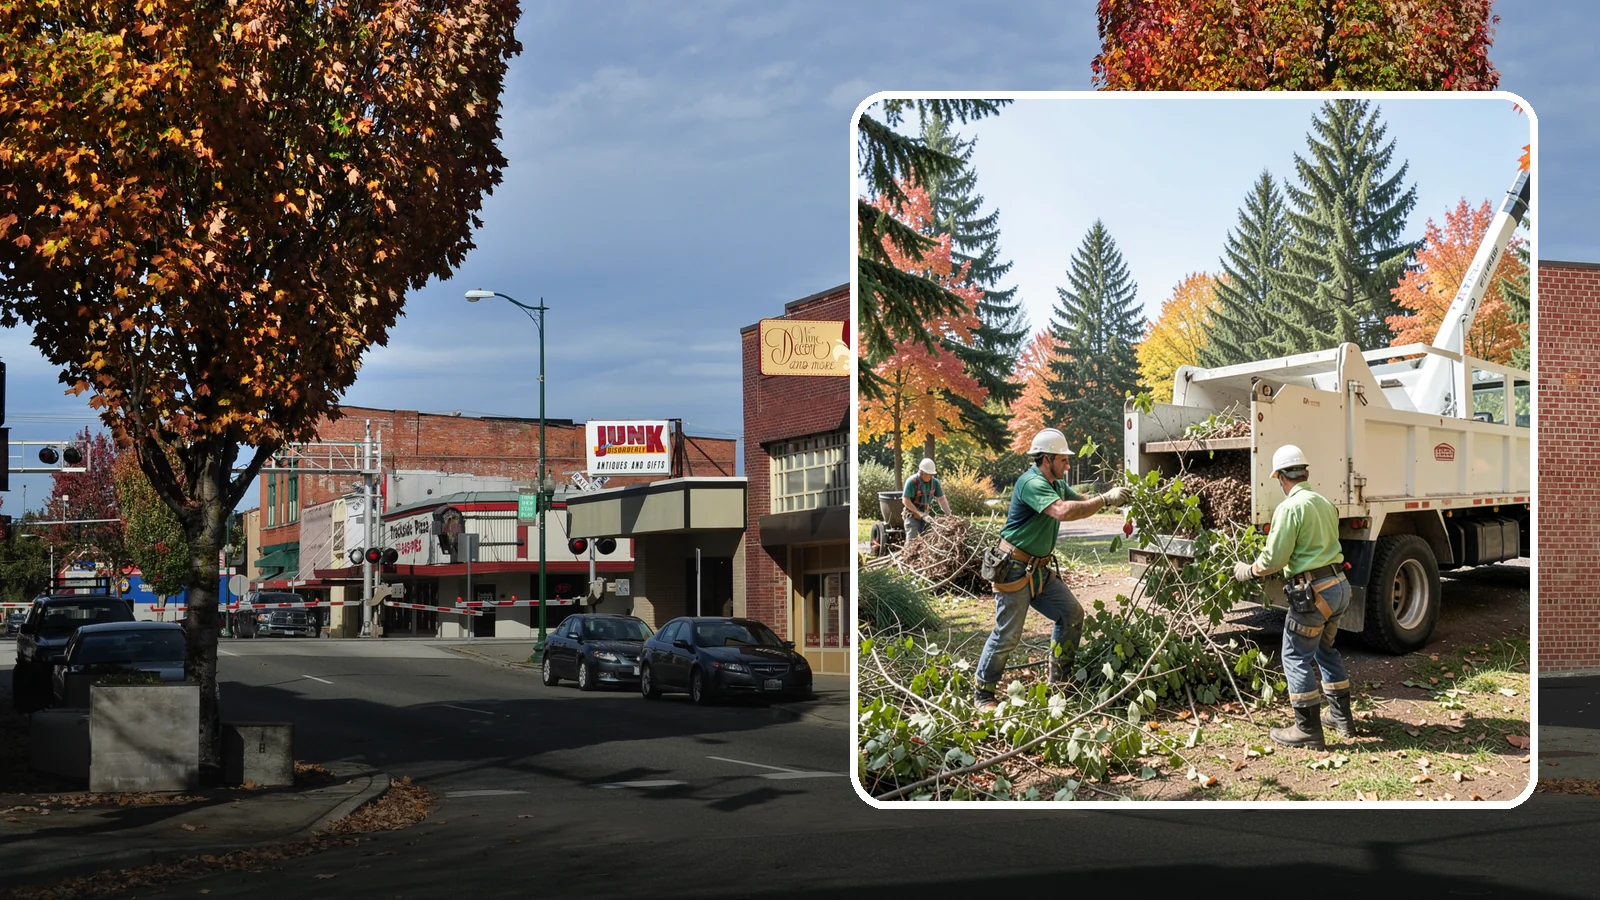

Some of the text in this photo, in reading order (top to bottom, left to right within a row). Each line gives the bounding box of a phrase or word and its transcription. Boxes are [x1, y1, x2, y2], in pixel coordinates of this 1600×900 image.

[595, 425, 665, 457] JUNK
[607, 446, 646, 454] DISORDERLY
[597, 461, 665, 470] ANTIQUES AND GIFTS
[390, 519, 429, 540] Trackside Pizza
